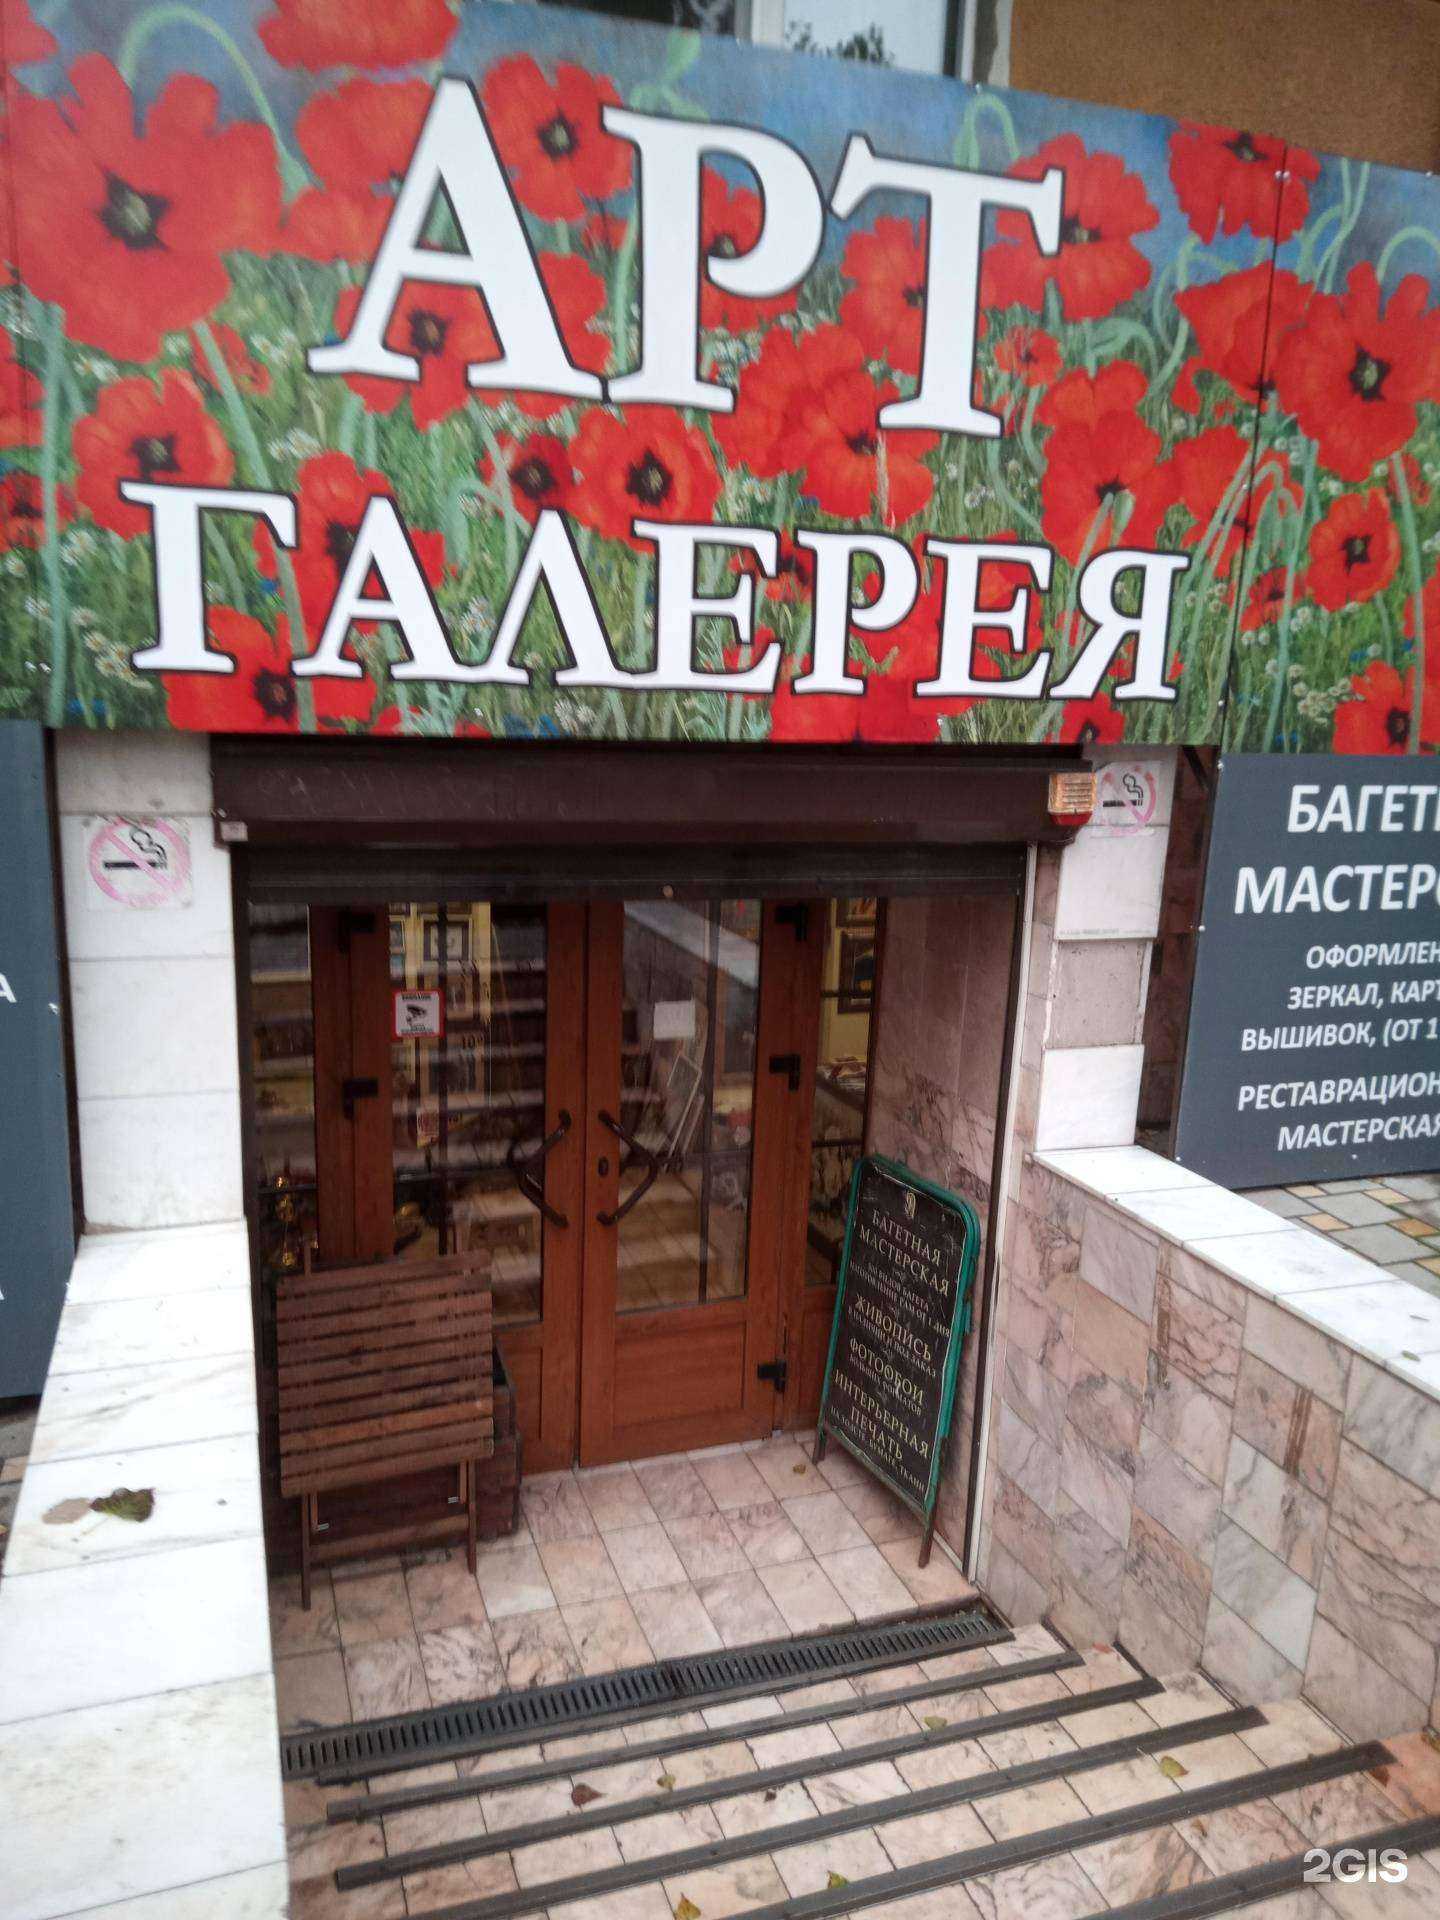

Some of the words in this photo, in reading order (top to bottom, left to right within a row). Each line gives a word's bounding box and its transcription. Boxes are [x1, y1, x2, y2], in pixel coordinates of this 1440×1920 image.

[308, 78, 1064, 437] АРТ
[120, 482, 1190, 701] ГАЛЕРЕЯ
[1287, 784, 1440, 834] БАГЕТ
[1234, 863, 1440, 915] МАСТЕР
[1287, 982, 1383, 1011] ЗЕРКАЛ,
[1241, 1021, 1376, 1052] ВЫШИВОК,
[1383, 1018, 1423, 1048] (ОТ
[860, 1224, 949, 1297] МАСТЕРСКАЯ
[872, 1209, 941, 1267] БАГЕТНАЯ
[855, 1293, 931, 1361] ЖИВОПИСЬ
[850, 1337, 923, 1406] ФОТООБОИ
[912, 1352, 936, 1379] ЗАКАЗ
[835, 1369, 929, 1459] ИНТЕРЬЕРНАЯ
[850, 1405, 902, 1460] ПЕЧАТЬ
